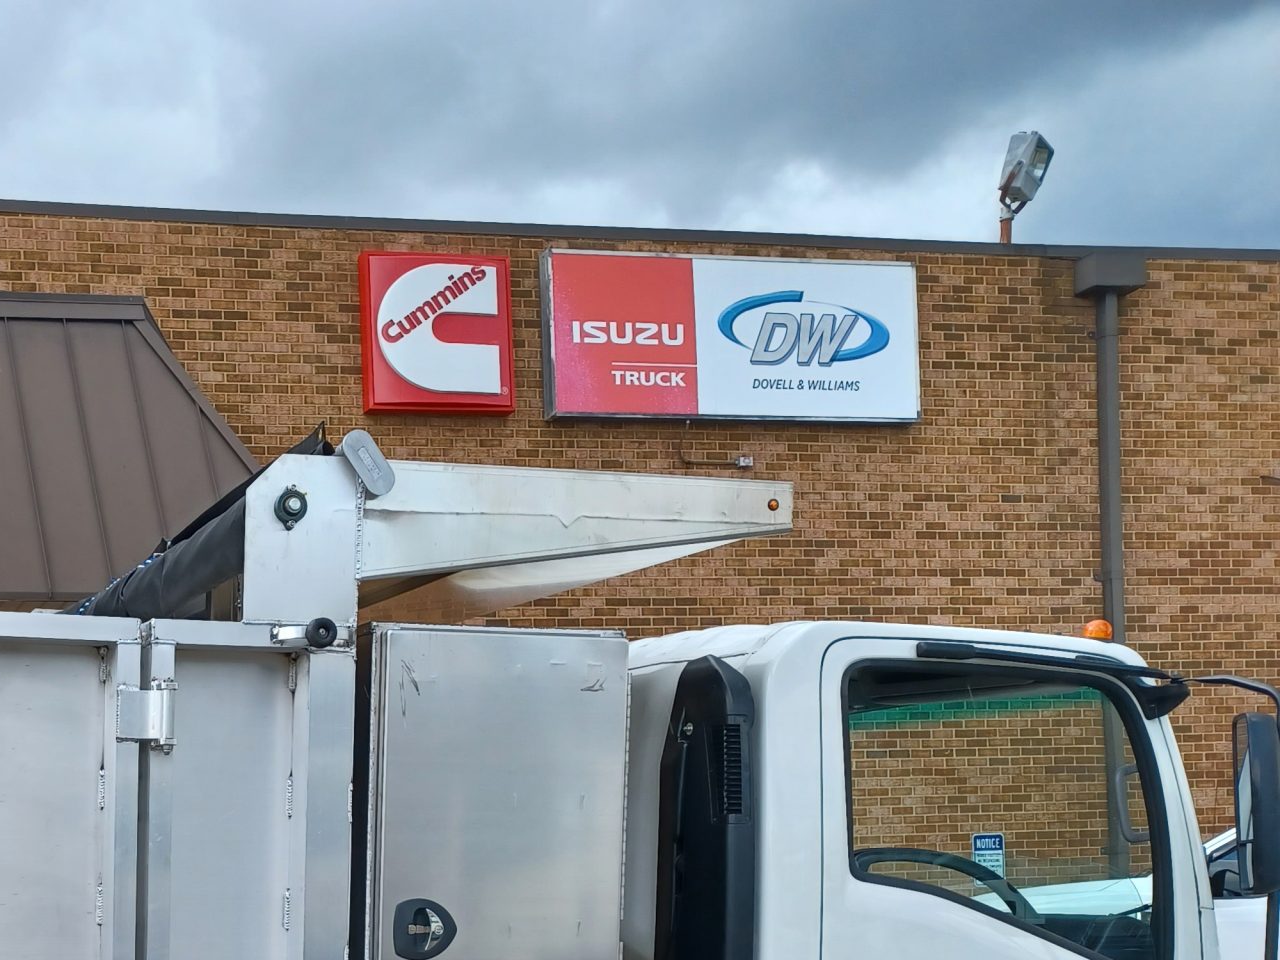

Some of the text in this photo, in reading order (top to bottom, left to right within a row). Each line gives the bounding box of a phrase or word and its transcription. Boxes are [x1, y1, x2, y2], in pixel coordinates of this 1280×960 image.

[381, 265, 487, 344] Cummins
[571, 320, 685, 346] ISUZU
[750, 312, 859, 367] DW
[611, 370, 687, 388] TRUCK
[752, 378, 861, 392] DOVELL & WILLIAMS
[976, 838, 1000, 848] NOTICE
